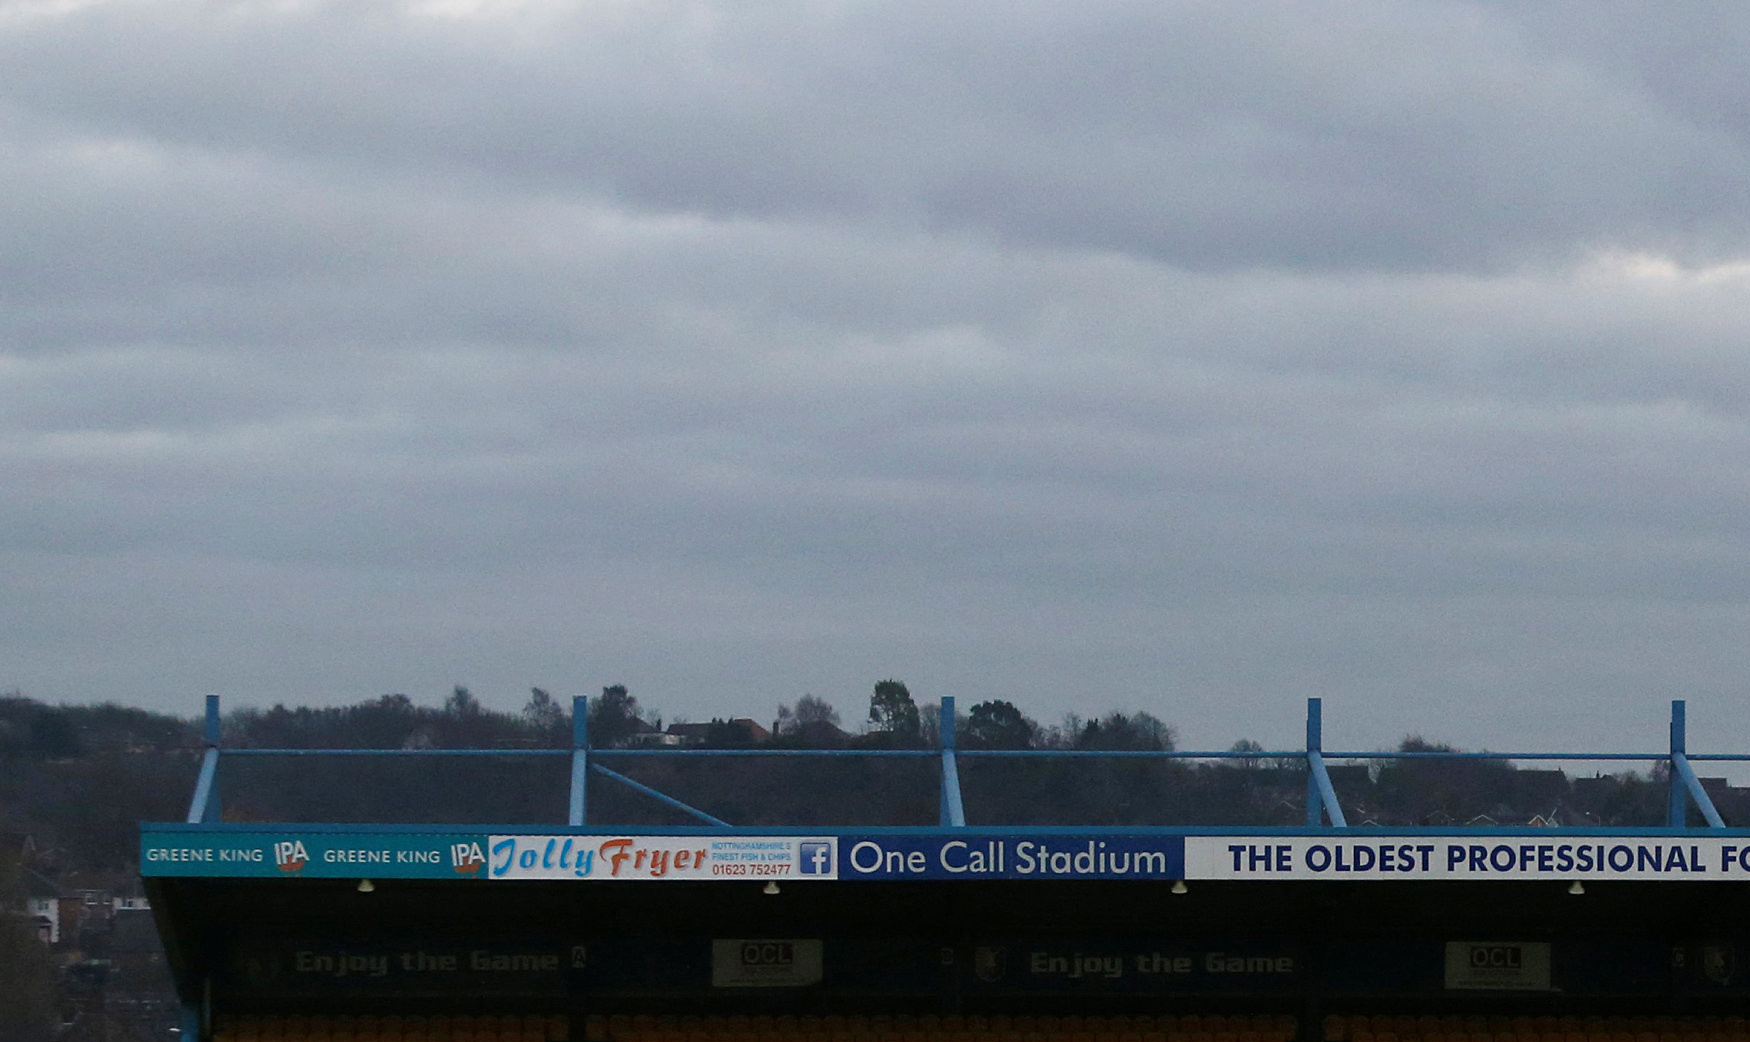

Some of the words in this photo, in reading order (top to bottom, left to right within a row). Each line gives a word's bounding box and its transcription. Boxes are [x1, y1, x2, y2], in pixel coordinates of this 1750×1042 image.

[146, 848, 214, 863] GREENE
[219, 849, 263, 863] KING
[274, 840, 309, 865] IPA
[323, 849, 390, 864] GREENE
[397, 850, 441, 864] KING
[450, 842, 486, 867] IPA
[493, 838, 594, 876] Jolly
[599, 839, 706, 877] Fryer
[712, 853, 738, 861] FINEST
[742, 853, 758, 861] FISH
[768, 853, 792, 861] CHIPS
[850, 841, 926, 874] One
[940, 840, 1005, 874] Call
[1015, 840, 1167, 875] Stadium
[1228, 844, 1293, 873] THE
[1304, 844, 1435, 873] OLDEST
[1447, 844, 1707, 873] PROFESSIONAL
[712, 864, 746, 876] 01623
[750, 864, 791, 876] 752477
[295, 951, 389, 977] Enjoy
[400, 951, 457, 972] the
[470, 951, 560, 972] Game
[743, 944, 792, 964] OCL
[1030, 952, 1123, 978] Enjoy
[1137, 952, 1193, 973] the
[1205, 952, 1294, 973] Game
[1472, 949, 1520, 968] OCL
